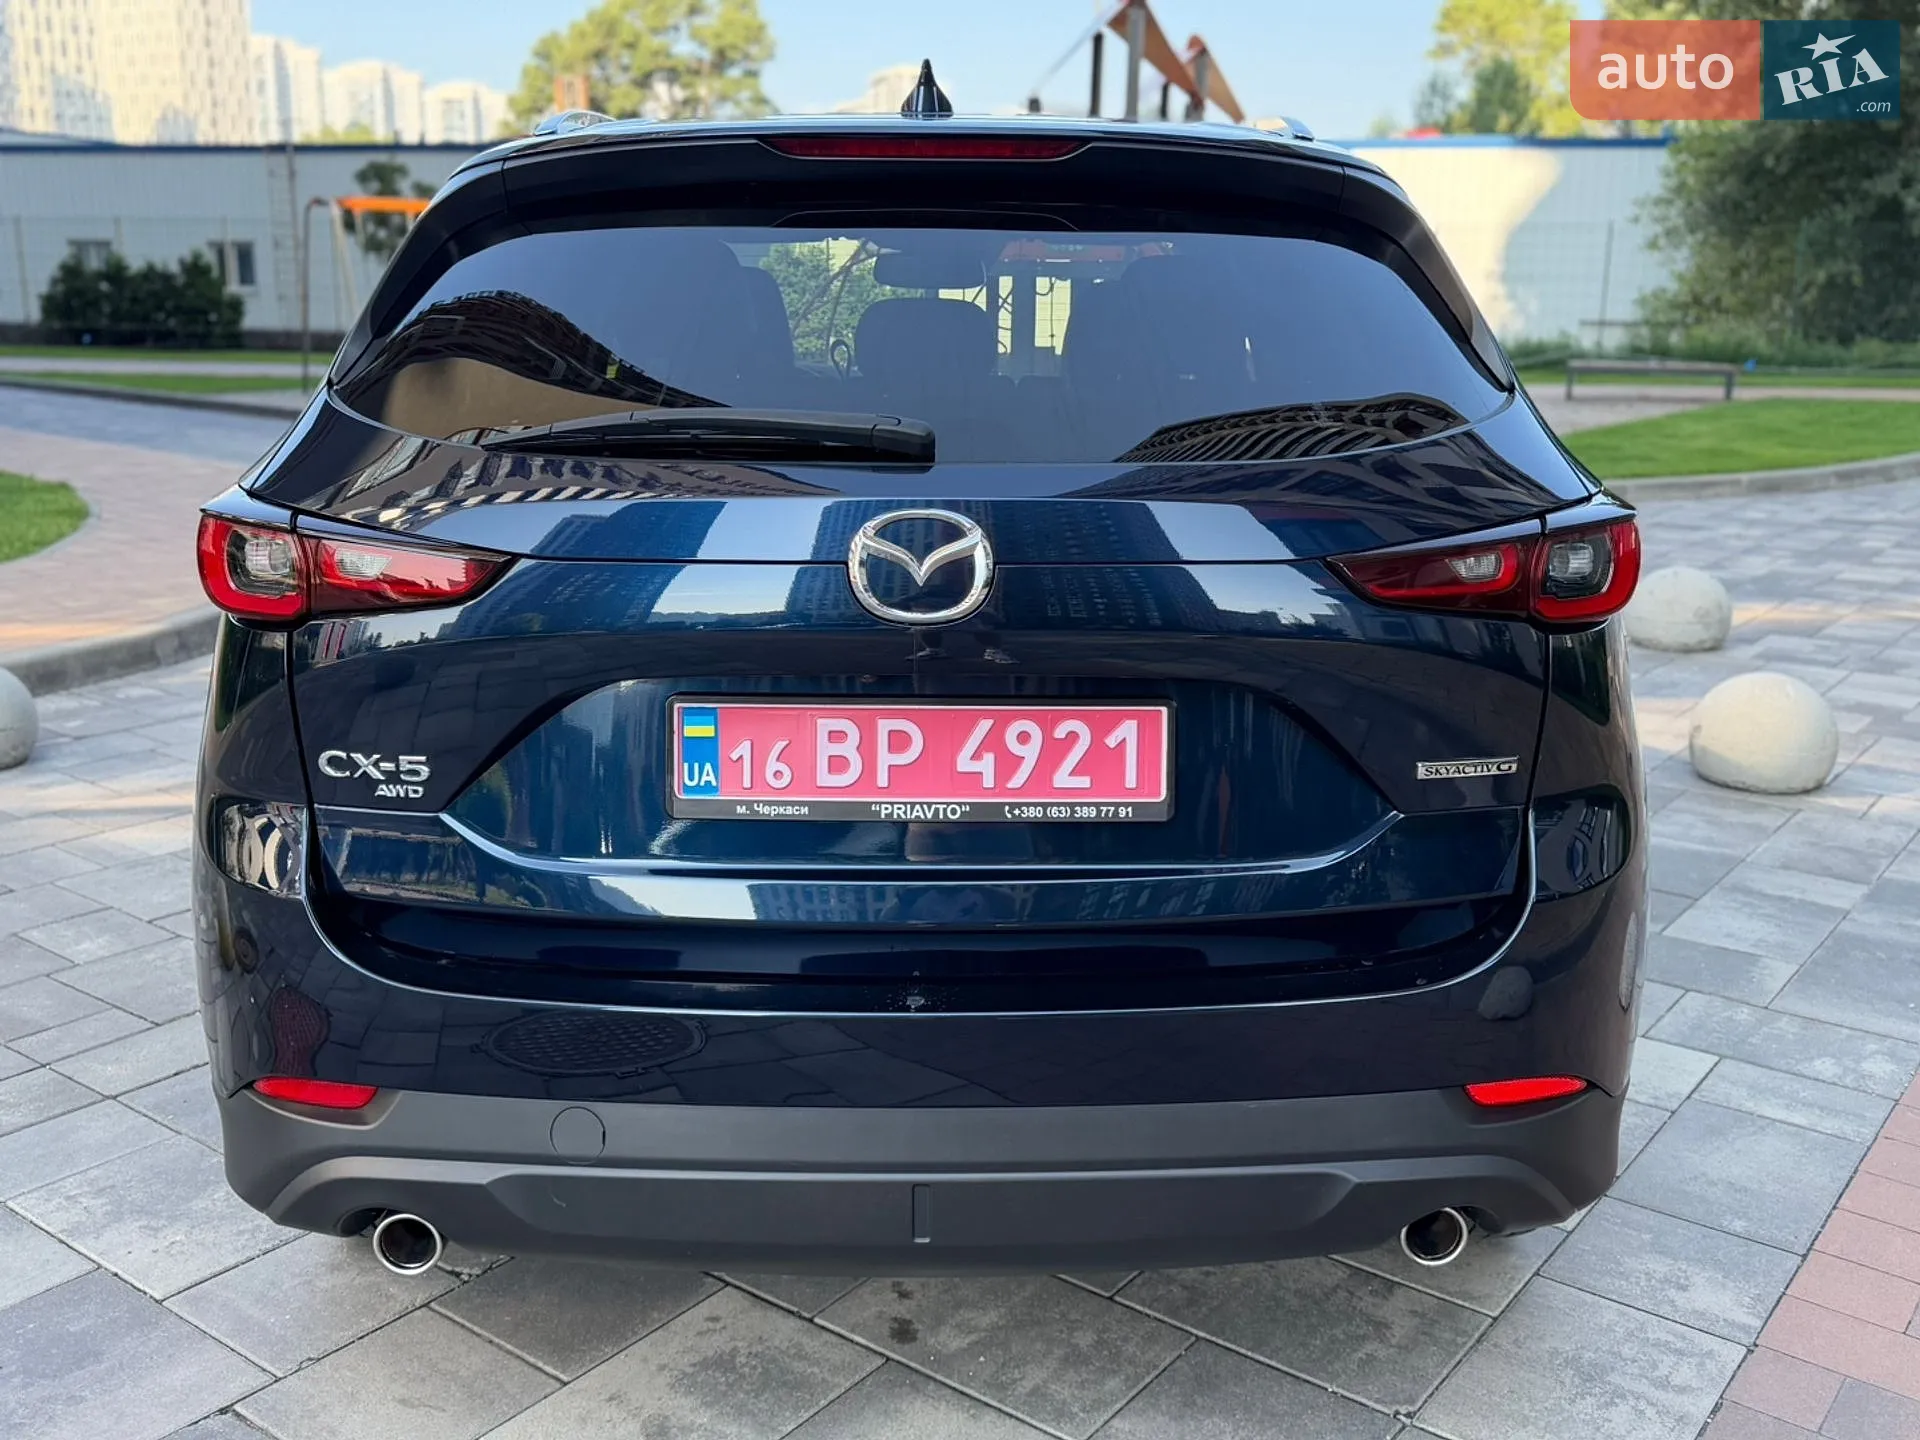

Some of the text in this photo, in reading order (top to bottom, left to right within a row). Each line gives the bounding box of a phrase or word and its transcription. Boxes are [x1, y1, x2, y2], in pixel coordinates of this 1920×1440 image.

[728, 717, 1139, 790] 16 BP 4921
[318, 750, 430, 782] CX-5
[683, 763, 717, 787] UA
[375, 784, 424, 798] AWD
[736, 803, 809, 815] м. Черкаси
[1013, 806, 1132, 819] +380 (63) 389 77 91
